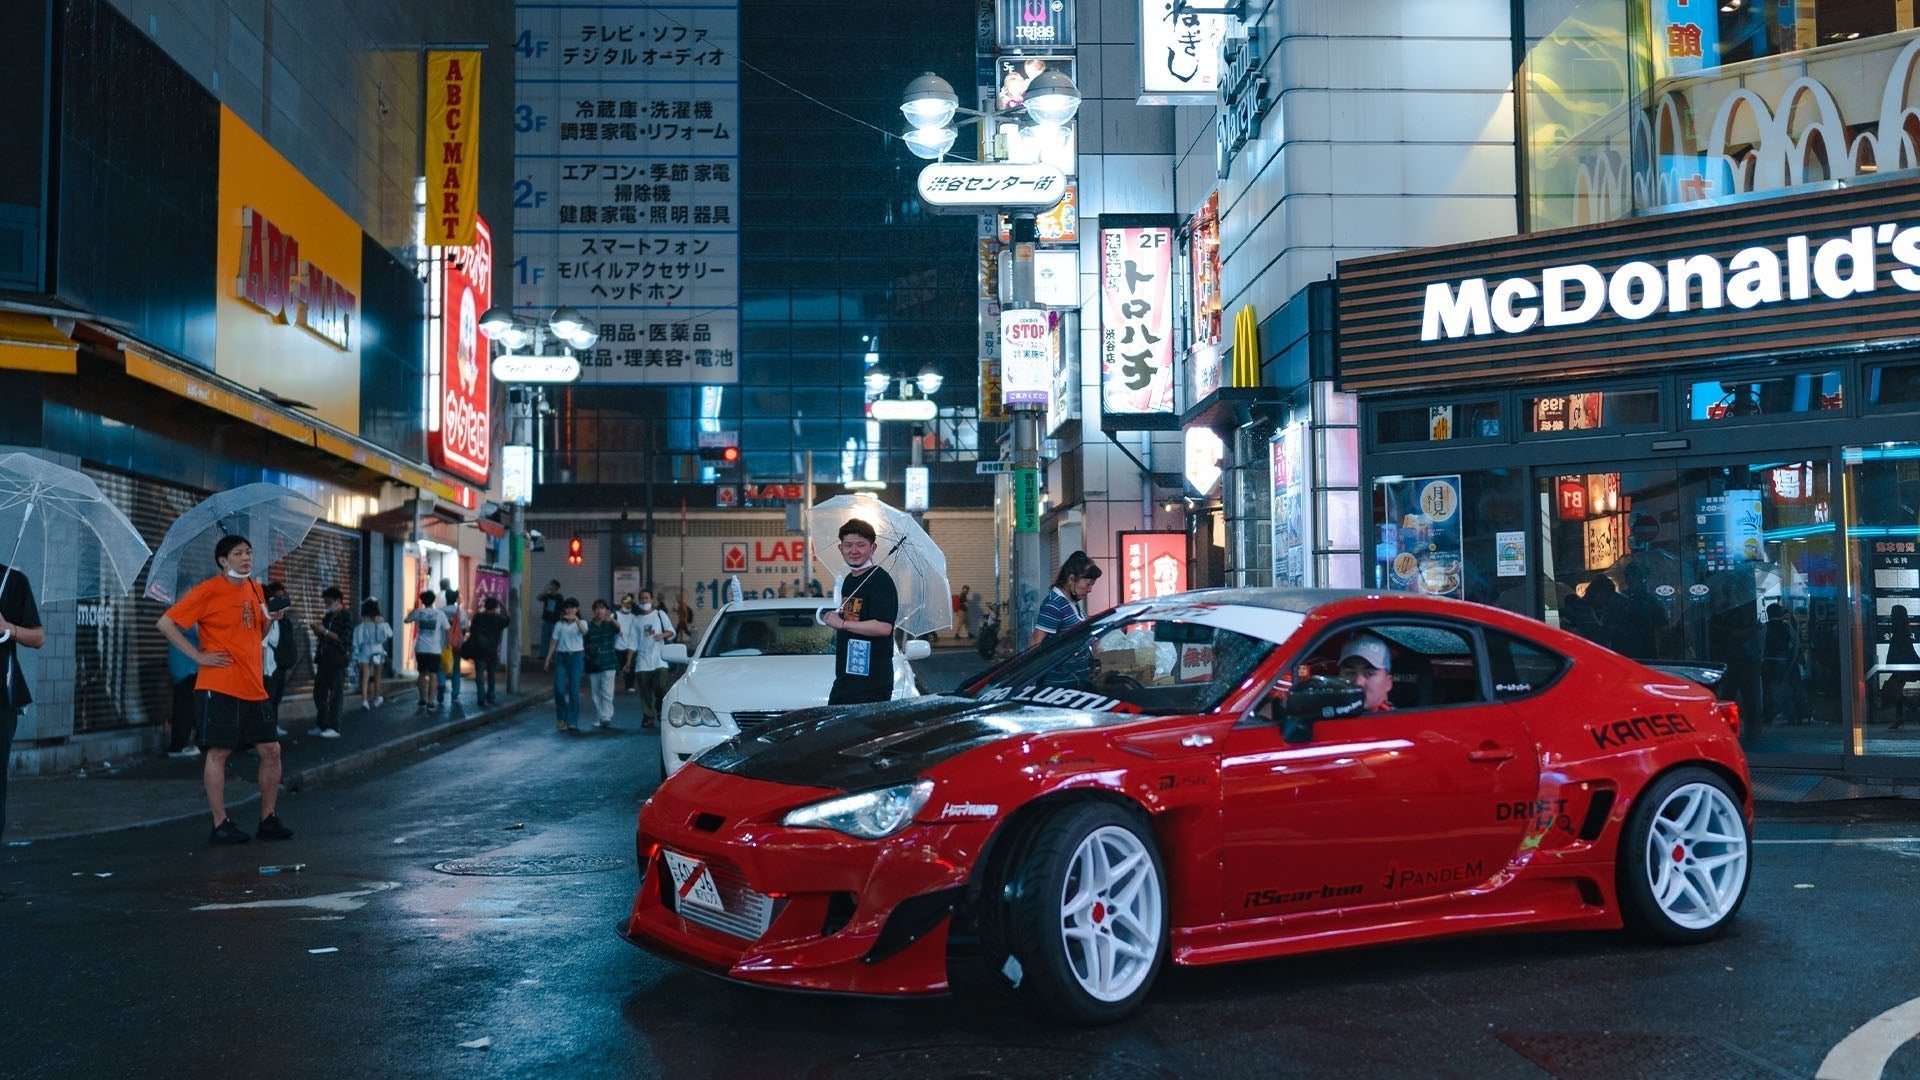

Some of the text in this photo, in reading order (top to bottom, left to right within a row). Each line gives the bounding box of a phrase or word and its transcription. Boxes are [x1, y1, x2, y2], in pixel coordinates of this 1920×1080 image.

[581, 25, 708, 43] テレビ・ソファ
[1016, 22, 1055, 41] rejas
[515, 29, 548, 58] 4F
[563, 48, 724, 65] デジタルオーディオ
[515, 104, 548, 133] 3F
[576, 100, 713, 119] 冷蔵庫・洗濯機
[560, 122, 730, 141] 調理家電・リフォーム
[562, 164, 730, 182] エアコン・季節家電
[614, 183, 671, 202] 掃除機
[926, 174, 1057, 192] 渋谷センター街
[514, 179, 548, 208] 2F
[559, 205, 730, 224] 健康家電・照明器具
[581, 238, 709, 255] スマートフォン
[1139, 233, 1166, 248] 2F
[514, 256, 545, 285] 1F
[557, 262, 725, 280] モバイルアクセサリー
[590, 283, 684, 300] ヘッドホン
[1420, 223, 1920, 341] McDonald's
[598, 323, 711, 343] 用品・医薬品
[1012, 323, 1045, 340] STOP
[1120, 259, 1162, 391] トロハチ
[1105, 329, 1116, 364] 渋谷店
[577, 349, 733, 367] 粧品・理美容・電池
[1590, 713, 1696, 750] KANSEI
[1496, 799, 1569, 822] DRIFT
